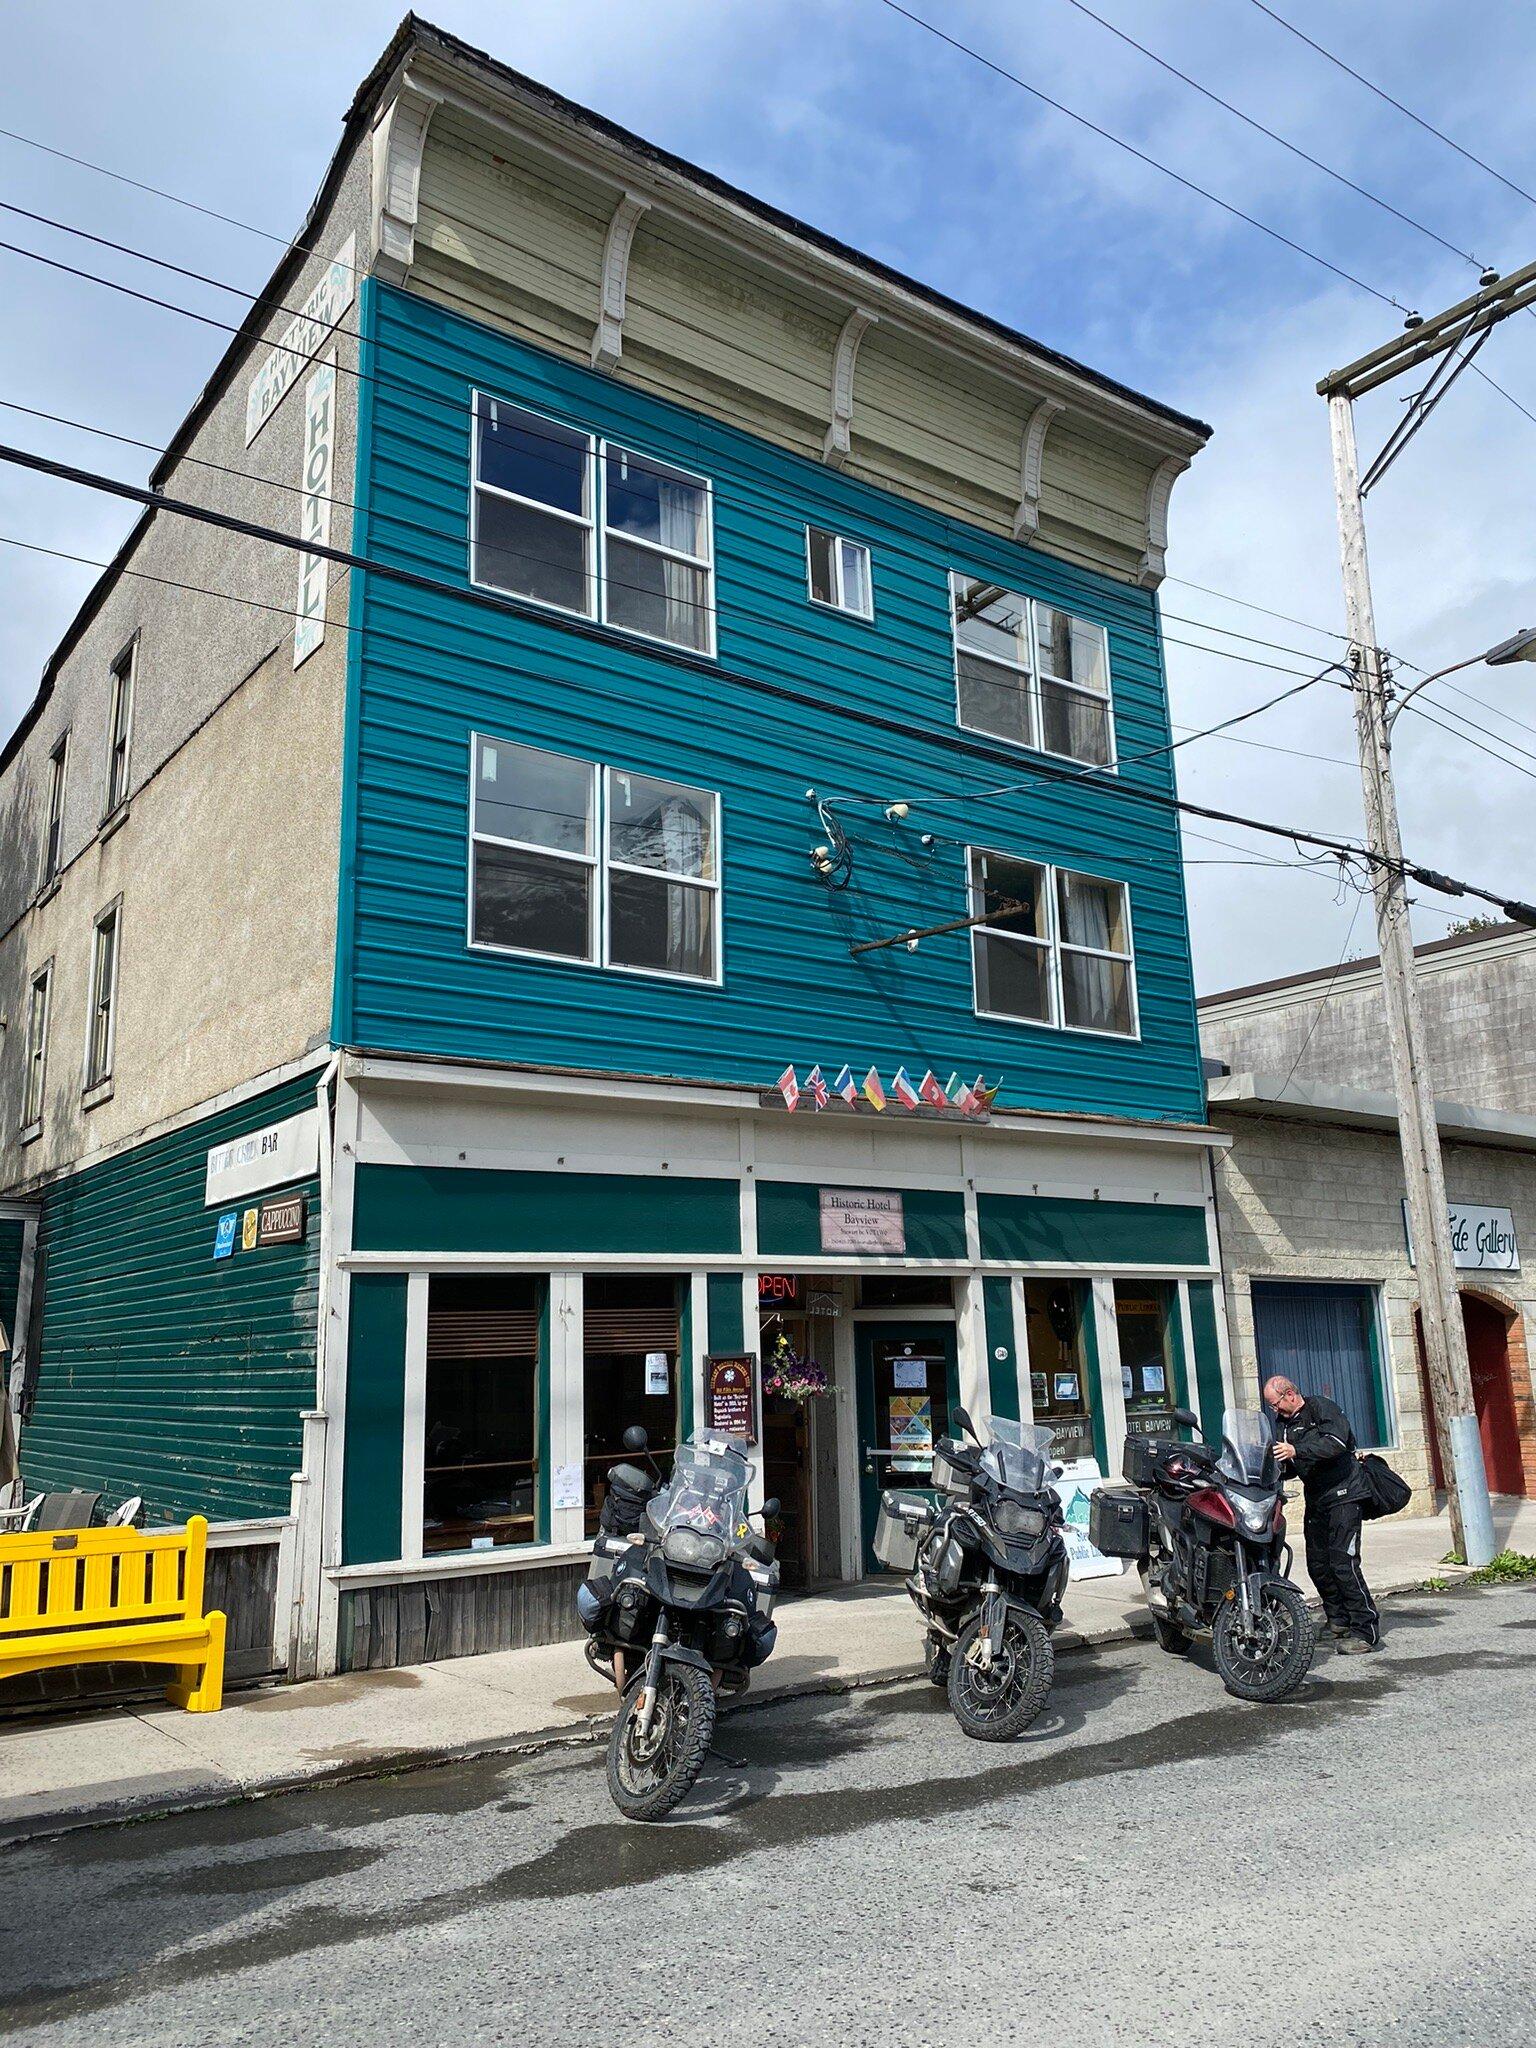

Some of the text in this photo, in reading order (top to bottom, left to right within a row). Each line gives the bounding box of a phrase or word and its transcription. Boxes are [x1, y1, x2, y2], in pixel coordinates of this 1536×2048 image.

[269, 280, 328, 374] HISTORIC
[261, 294, 335, 418] BAYVIEW
[301, 396, 331, 622] HOTEL
[261, 1132, 278, 1155] BAR
[831, 1196, 891, 1210] Historic Hotel
[261, 1206, 300, 1232] CAPPUCCINO
[844, 1213, 880, 1226] Bayview
[1451, 1218, 1515, 1268] de Gallery
[1055, 1425, 1085, 1440] BAYVIEW
[1128, 1419, 1172, 1434] OTEL BAYVIEW
